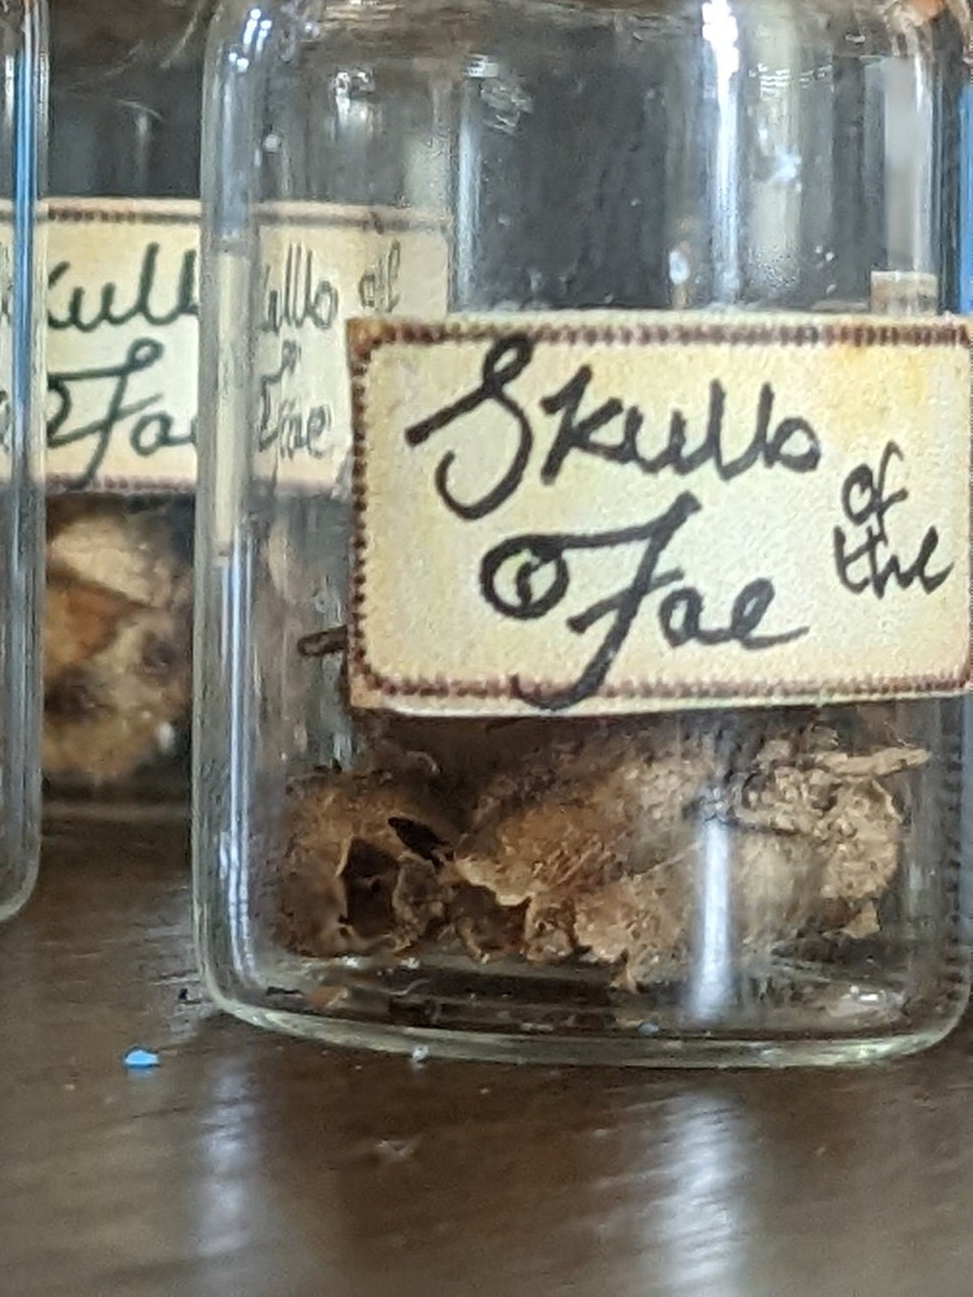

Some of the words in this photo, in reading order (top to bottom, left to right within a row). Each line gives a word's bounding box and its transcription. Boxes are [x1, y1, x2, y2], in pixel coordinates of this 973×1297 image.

[404, 334, 823, 522] Skulls
[841, 439, 911, 540] of
[479, 490, 812, 712] Fae
[833, 525, 955, 600] the
